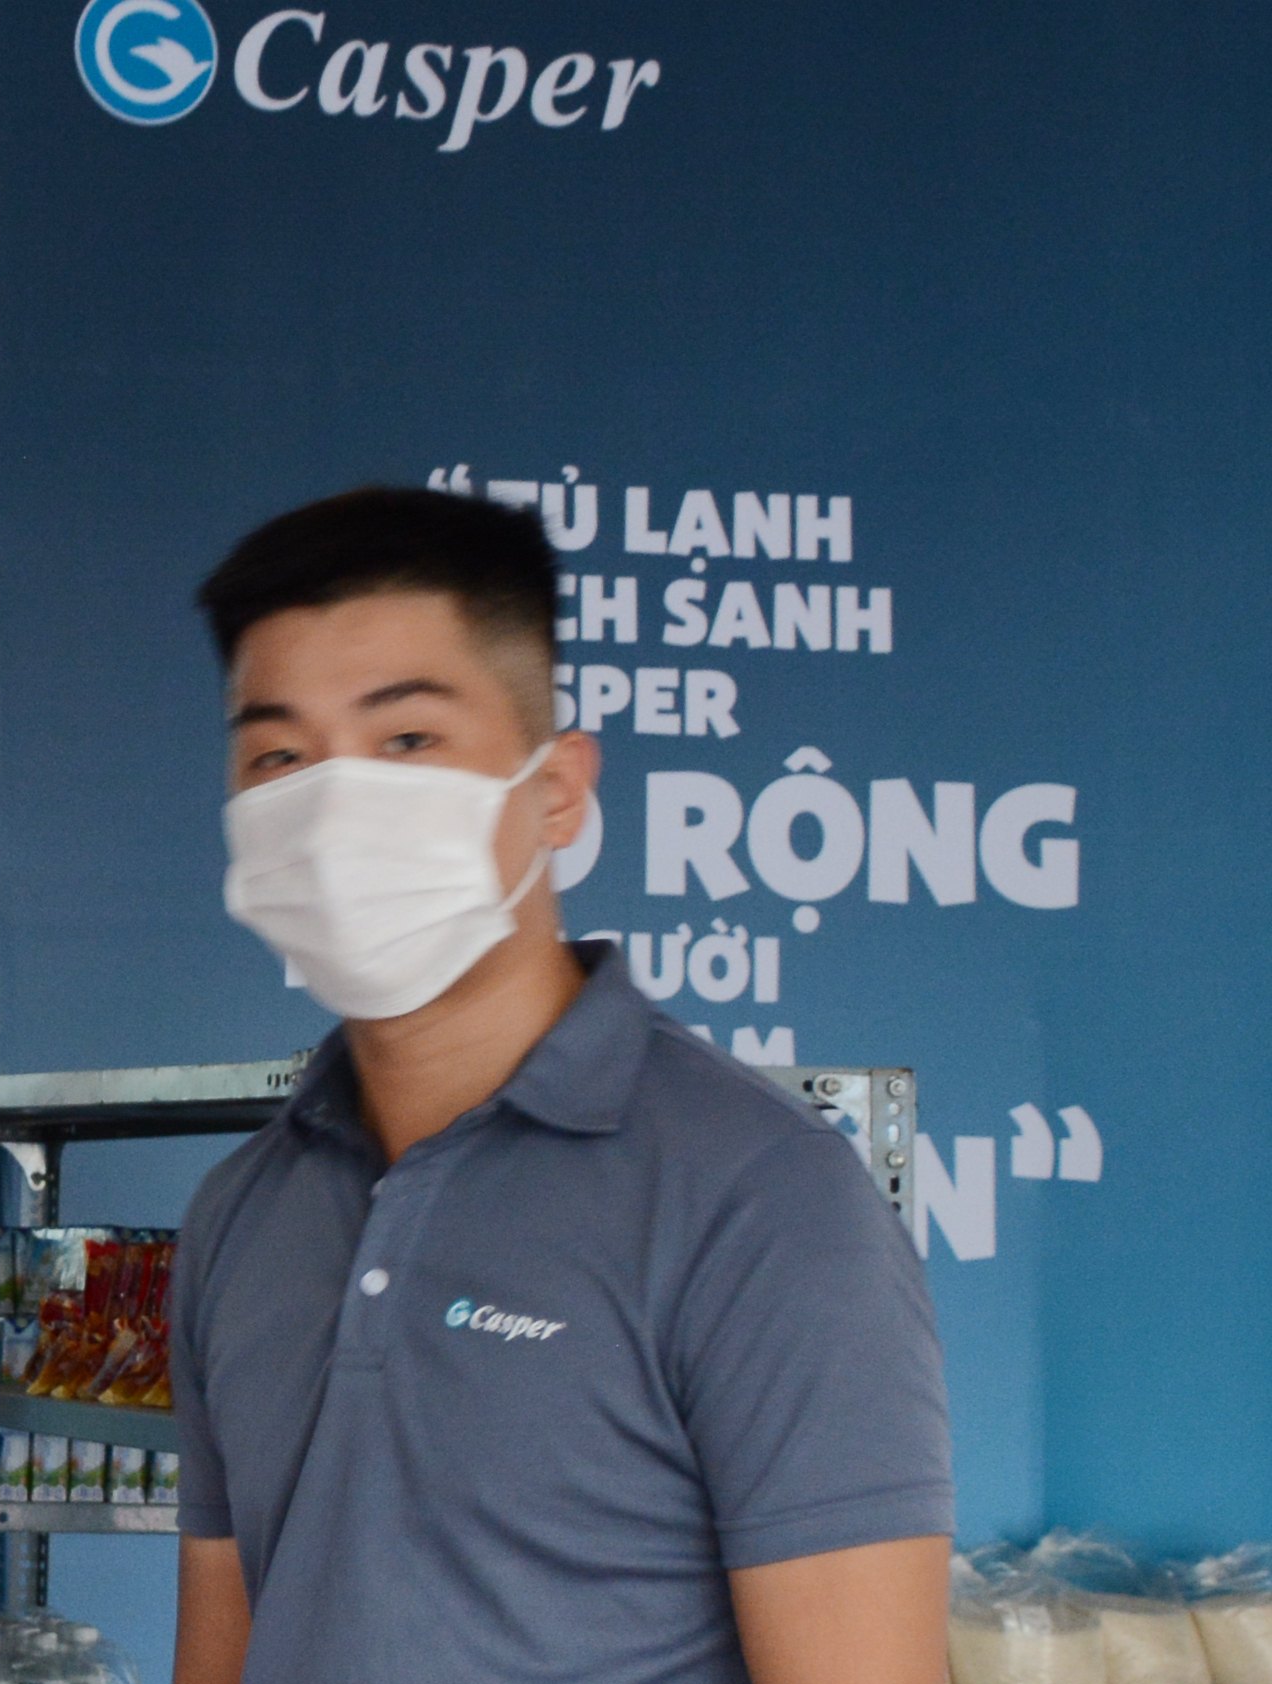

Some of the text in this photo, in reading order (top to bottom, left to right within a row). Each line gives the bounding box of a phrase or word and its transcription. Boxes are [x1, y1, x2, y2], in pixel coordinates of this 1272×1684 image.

[233, 9, 661, 152] Casper
[624, 486, 854, 574] LẠNH
[662, 577, 894, 655] SANH
[644, 745, 1081, 934] RỘNG
[469, 1304, 567, 1342] Casper
